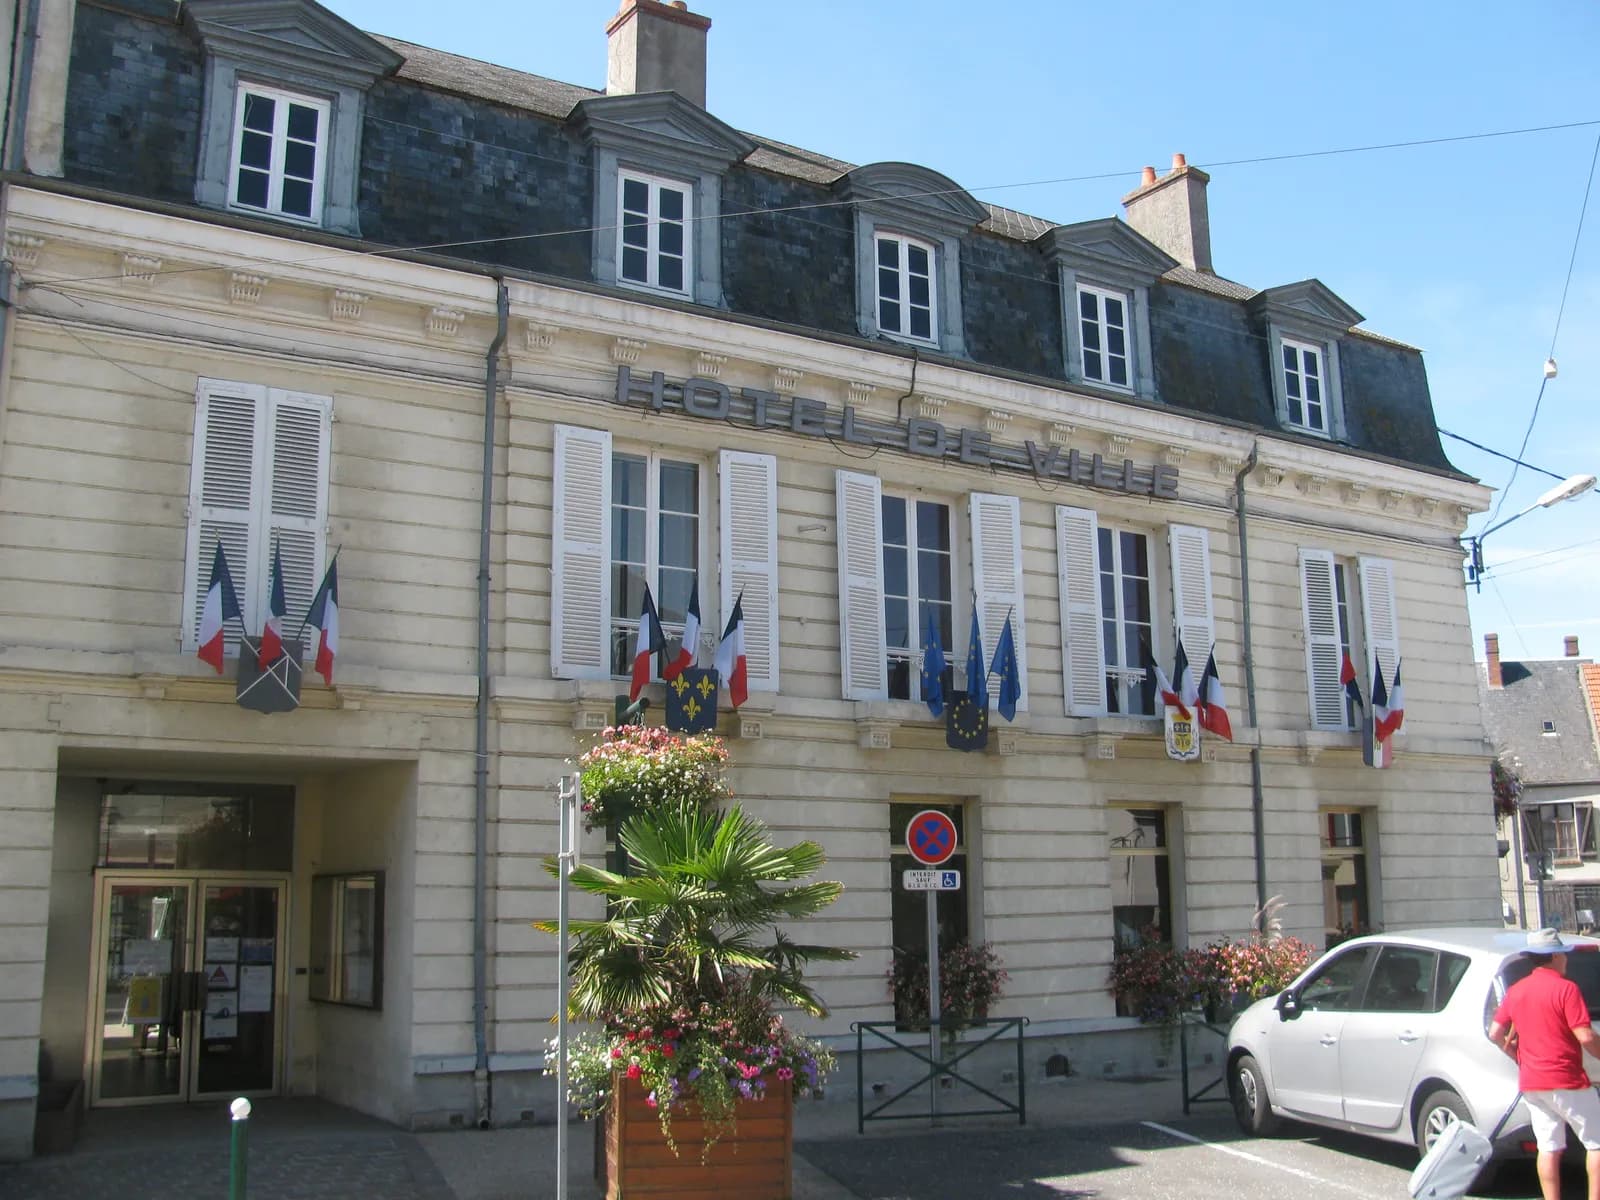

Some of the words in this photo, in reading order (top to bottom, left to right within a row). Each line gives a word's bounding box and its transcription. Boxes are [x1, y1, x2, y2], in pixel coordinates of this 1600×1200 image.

[616, 364, 873, 444] HOTEL
[907, 417, 992, 466] DE
[1024, 440, 1179, 498] VILLE
